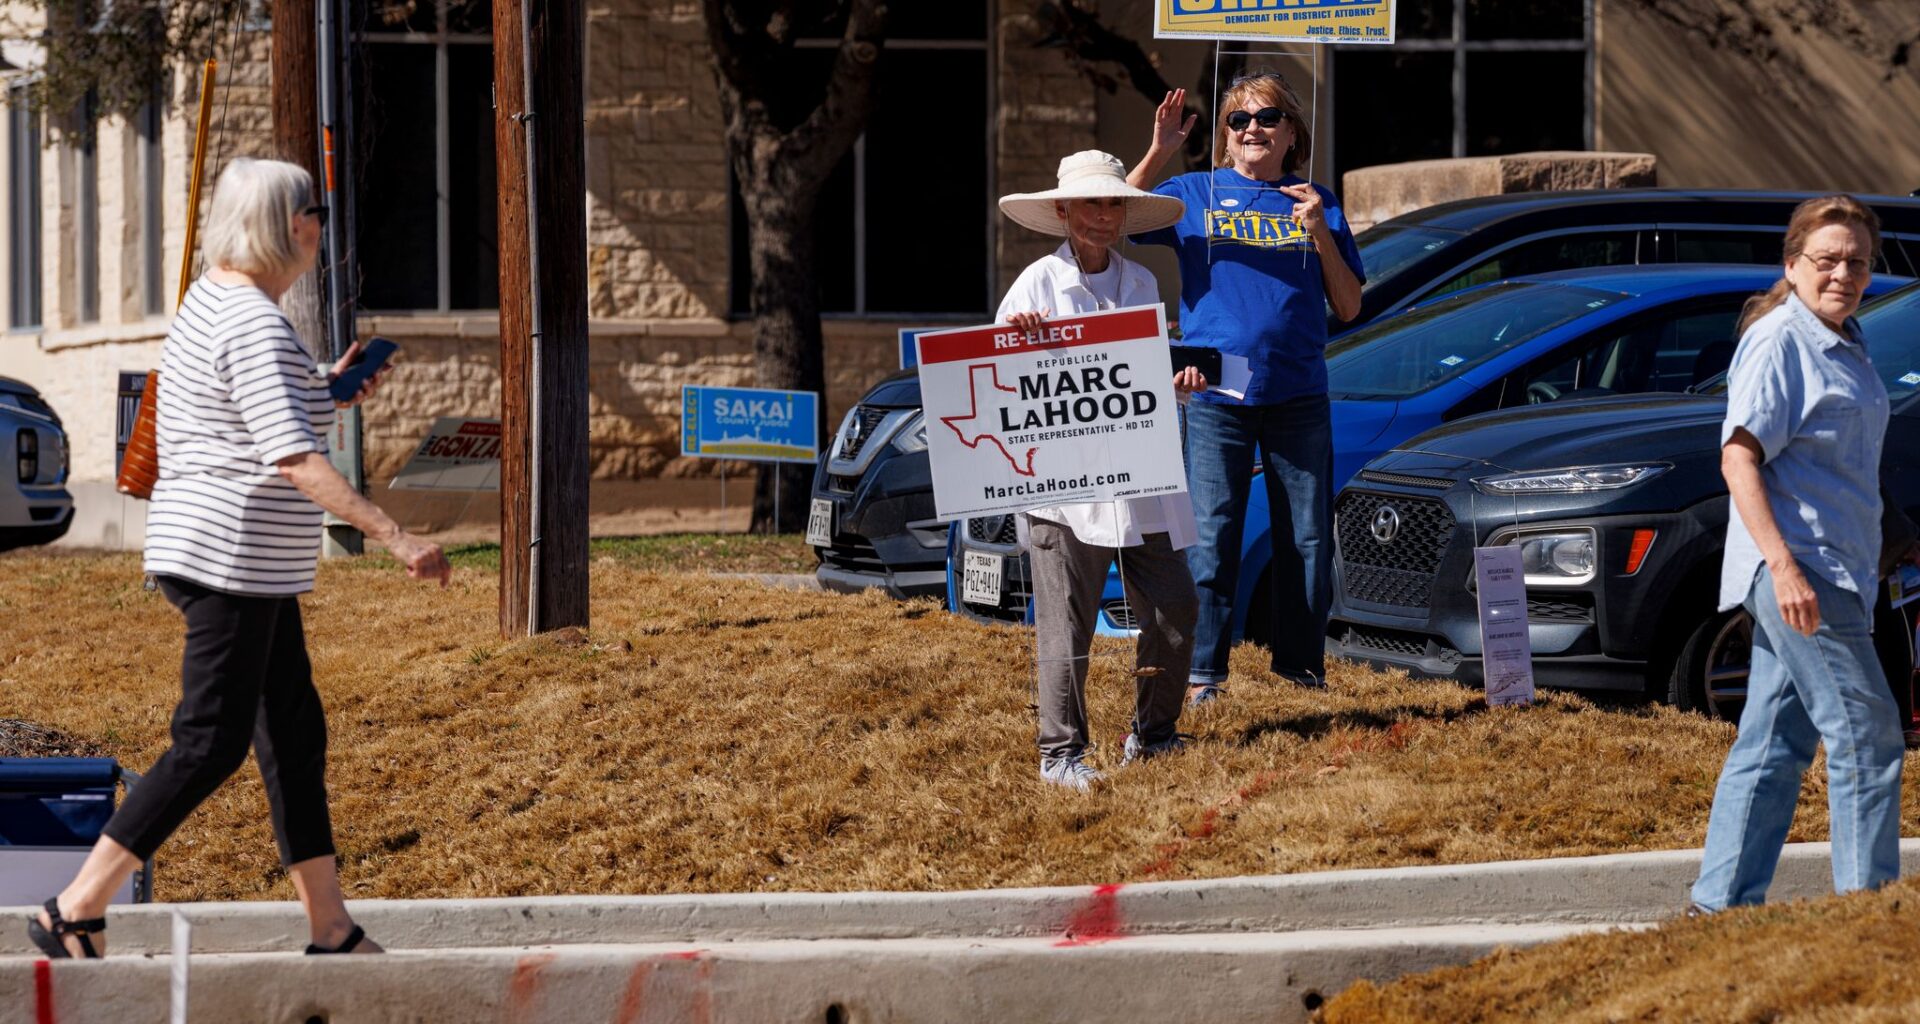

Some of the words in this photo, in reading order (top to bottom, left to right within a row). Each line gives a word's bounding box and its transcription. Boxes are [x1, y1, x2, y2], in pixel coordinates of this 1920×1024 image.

[1225, 13, 1271, 24] DEMOCRAT
[1273, 12, 1290, 21] FOR
[1292, 10, 1331, 20] DISTRICT
[1334, 7, 1376, 18] ATTORNEY
[1306, 25, 1336, 35] Justice.
[1338, 25, 1363, 36] Ethics.
[1365, 26, 1388, 36] Trust.
[993, 324, 1085, 349] RE-ELECT
[1036, 353, 1109, 369] REPUBLICAN
[1018, 363, 1132, 401] MARC
[686, 390, 697, 452] RE-ELECT
[716, 416, 756, 426] COUNTY
[759, 417, 790, 428] JUDGE
[1008, 433, 1036, 444] STATE
[1038, 424, 1116, 441] REPRESENTATIVE
[1125, 421, 1139, 431] HD
[1140, 419, 1154, 430] 121
[428, 435, 501, 459] GONZA
[984, 472, 1131, 499] MarcLaHood.com
[976, 555, 992, 567] TEXAS
